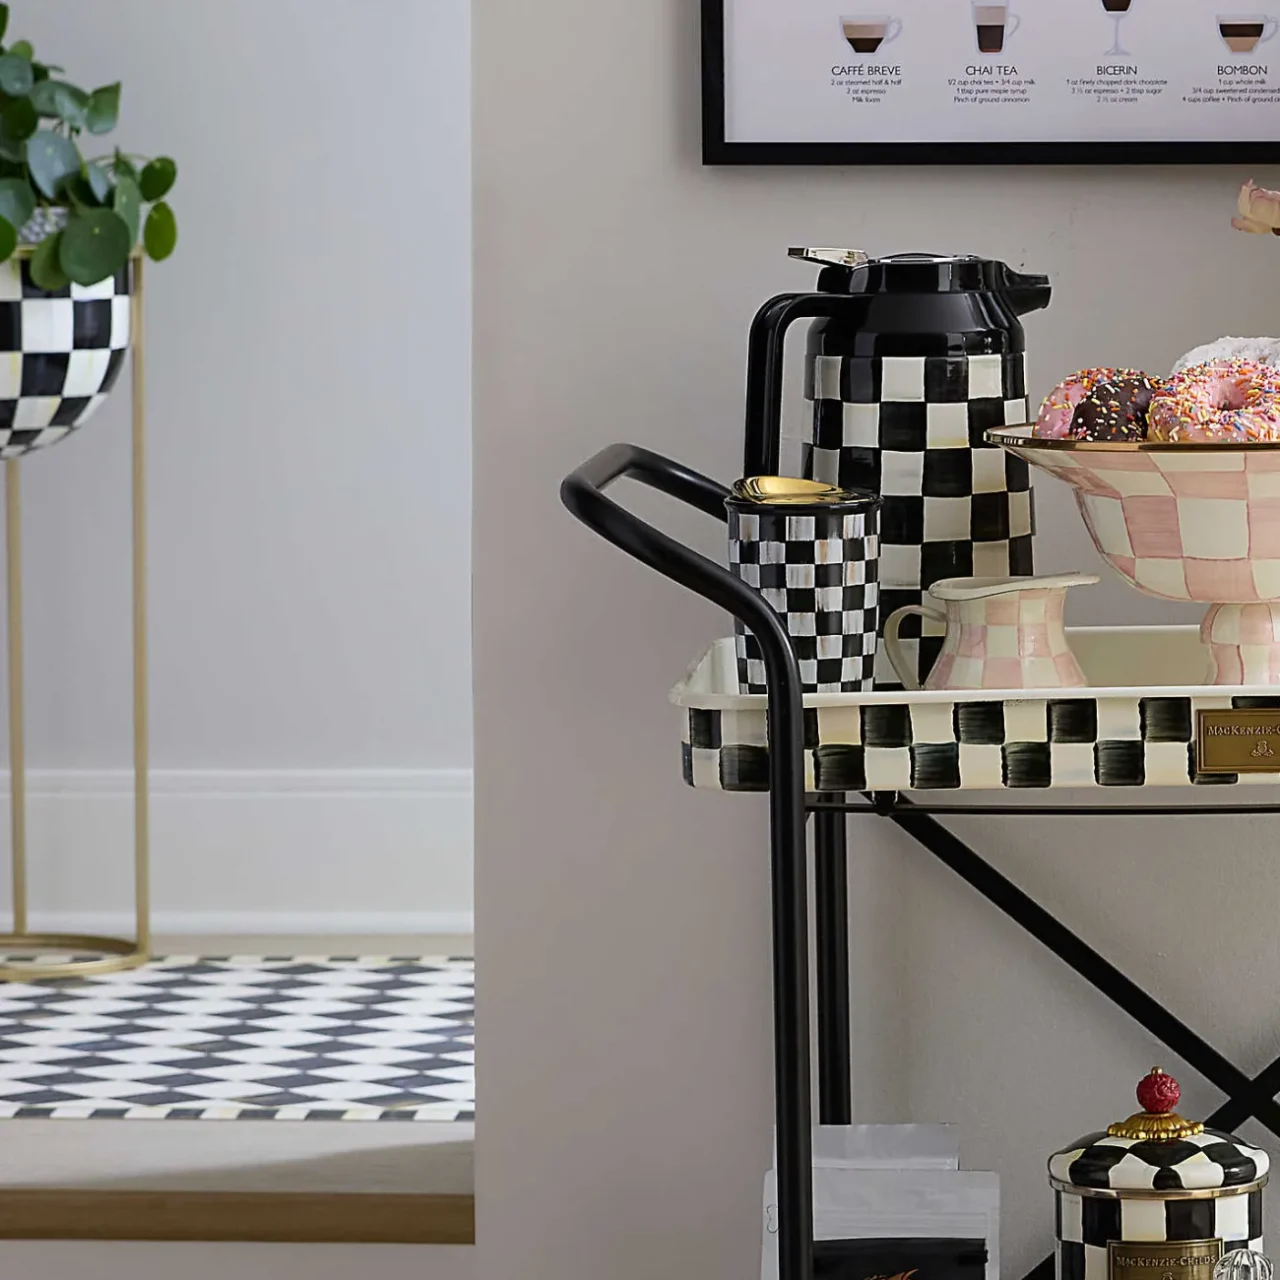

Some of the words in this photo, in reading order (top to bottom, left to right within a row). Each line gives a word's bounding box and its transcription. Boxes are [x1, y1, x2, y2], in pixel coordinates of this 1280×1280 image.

[831, 64, 864, 76] CAFFÉ
[867, 66, 901, 76] BREVE
[965, 66, 992, 76] CHAI
[996, 66, 1018, 76] TEA
[1096, 66, 1138, 76] BICERIN
[1218, 66, 1268, 76] BOMBON
